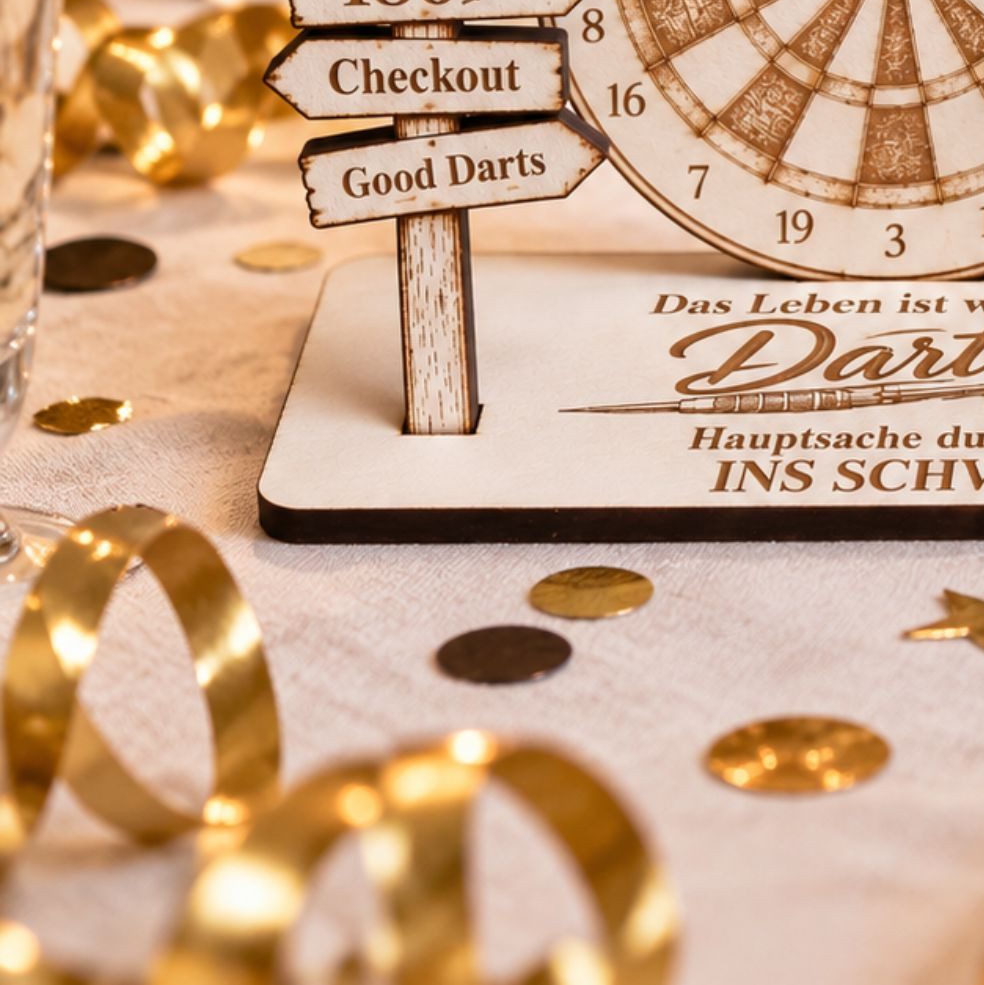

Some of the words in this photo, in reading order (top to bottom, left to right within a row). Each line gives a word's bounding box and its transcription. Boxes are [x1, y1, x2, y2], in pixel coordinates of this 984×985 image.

[581, 7, 605, 44] 8
[328, 57, 521, 96] Checkout
[607, 81, 647, 118] 16
[341, 158, 436, 200] Good
[445, 149, 546, 187] Darts
[687, 164, 710, 200] 7
[776, 209, 814, 245] 19
[884, 223, 906, 259] 3
[649, 292, 733, 315] Das
[748, 292, 882, 314] Leben
[897, 292, 946, 314] ist
[688, 425, 923, 456] Hauptsache
[708, 458, 816, 493] INS
